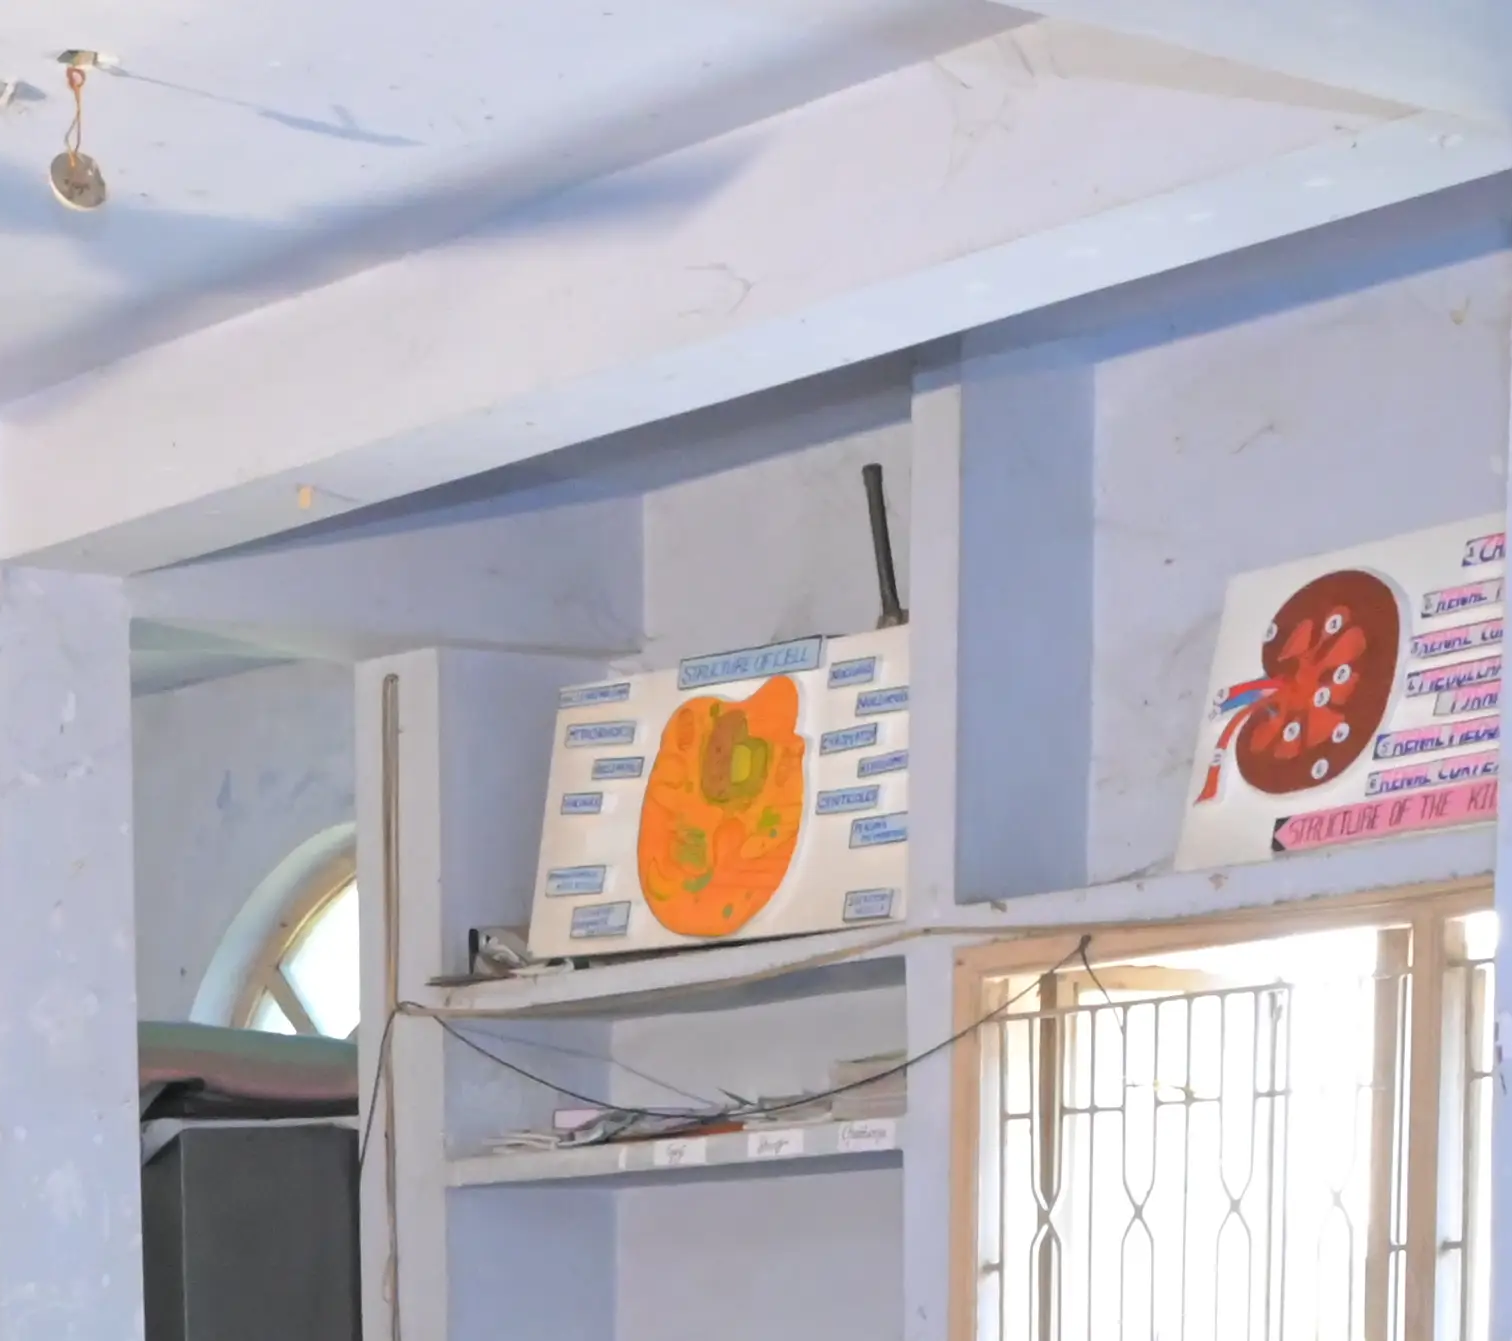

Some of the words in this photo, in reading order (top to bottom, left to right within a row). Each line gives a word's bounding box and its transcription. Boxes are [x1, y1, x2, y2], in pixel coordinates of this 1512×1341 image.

[1289, 804, 1378, 847] STRUCTURE
[1390, 795, 1414, 828] OF
[1420, 789, 1453, 821] THE
